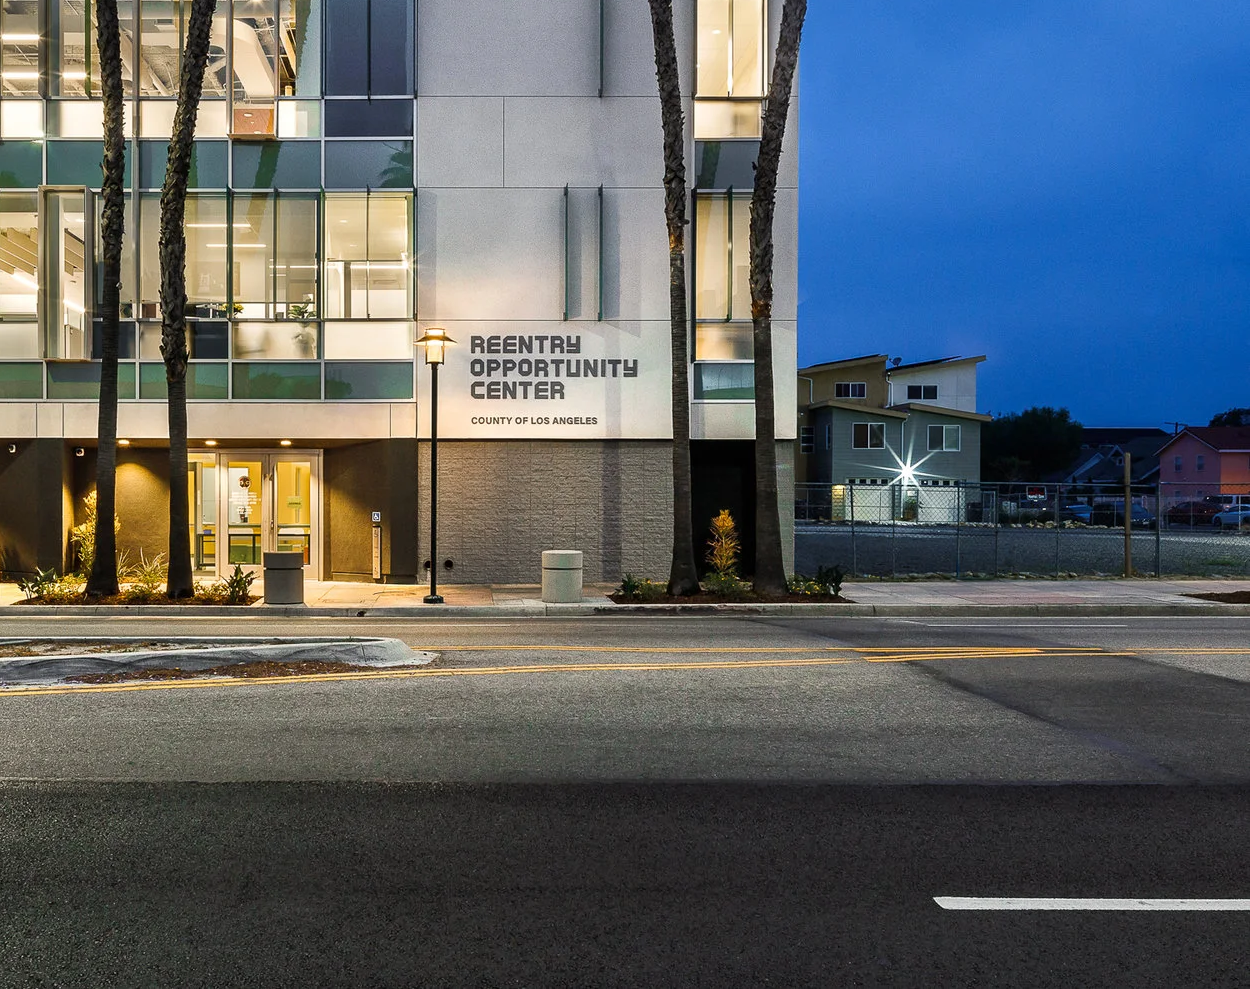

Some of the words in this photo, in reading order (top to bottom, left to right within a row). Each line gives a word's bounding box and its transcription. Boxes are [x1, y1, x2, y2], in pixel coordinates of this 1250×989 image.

[470, 335, 581, 354] REENTRY
[470, 358, 638, 377] OPPORTUNITY
[470, 381, 565, 400] CENTER
[471, 416, 513, 425] COUNTY
[515, 416, 529, 425] OF
[531, 416, 550, 425] LOS
[552, 416, 598, 425] ANGELES
